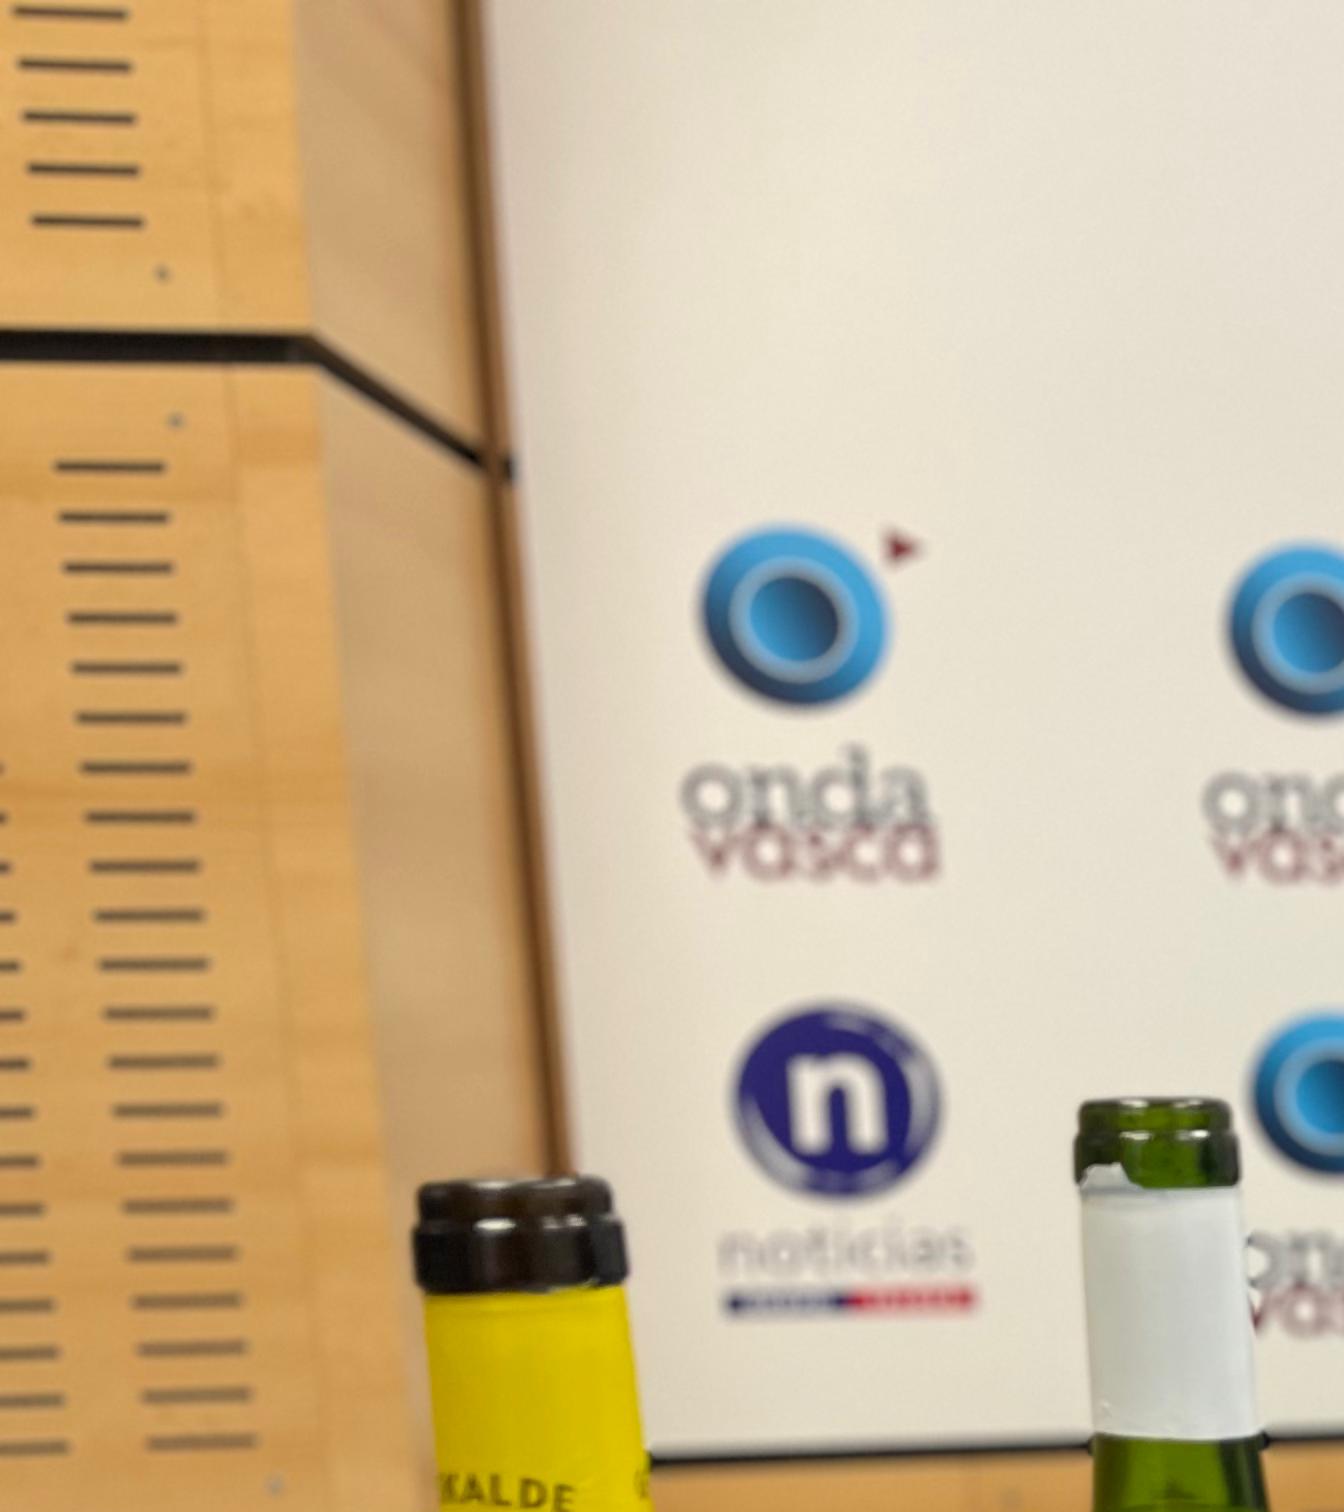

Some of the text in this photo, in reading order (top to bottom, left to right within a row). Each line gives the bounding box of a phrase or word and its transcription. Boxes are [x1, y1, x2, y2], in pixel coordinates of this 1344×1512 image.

[679, 744, 930, 830] onda
[690, 824, 942, 882] vasca
[718, 1222, 973, 1278] noticias
